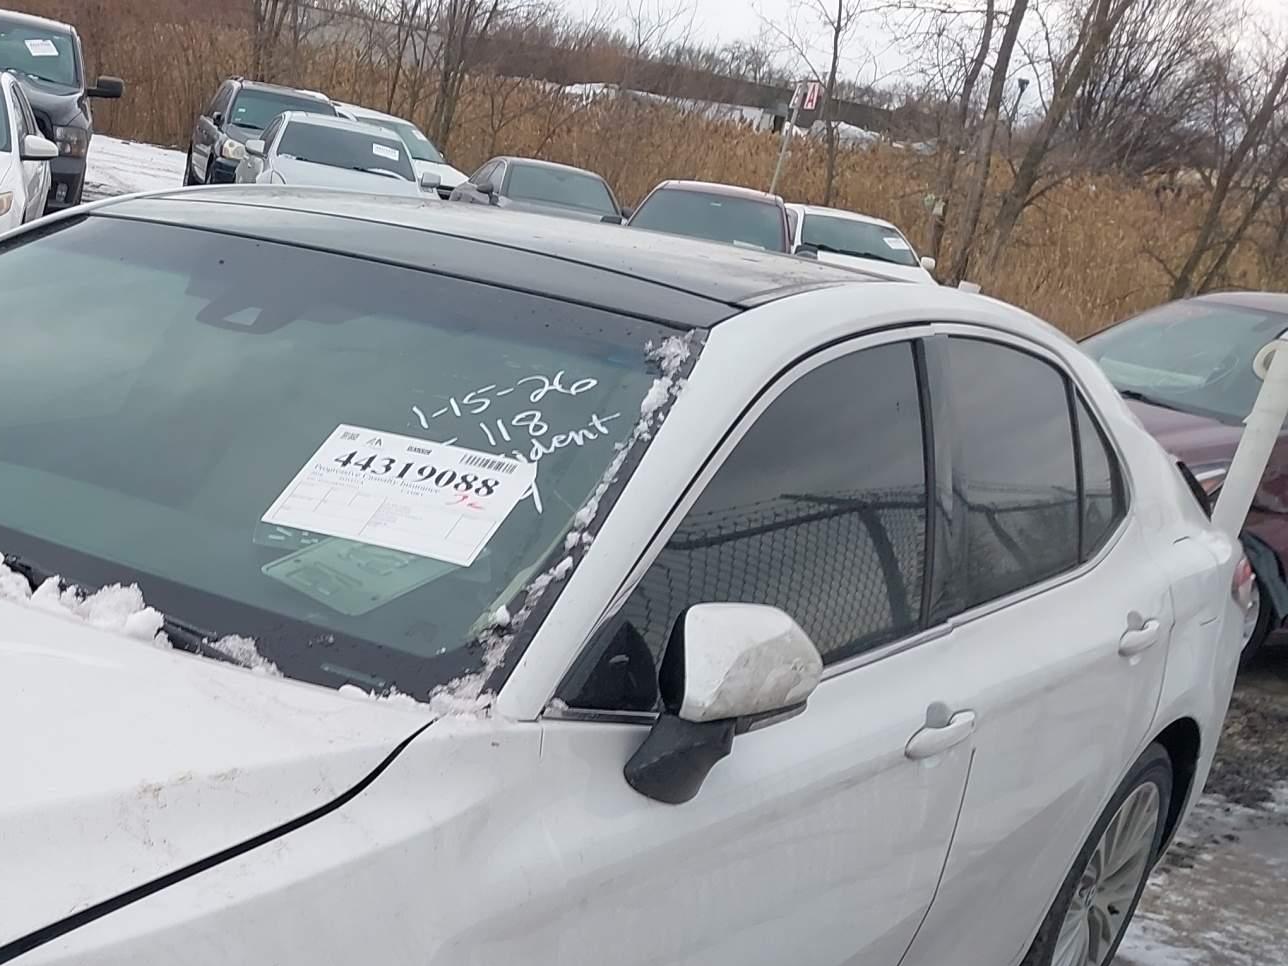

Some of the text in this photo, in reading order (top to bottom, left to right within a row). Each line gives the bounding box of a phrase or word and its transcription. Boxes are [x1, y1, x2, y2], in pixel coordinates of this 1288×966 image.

[412, 371, 598, 429] 1-15-26
[480, 410, 548, 446] 118
[334, 450, 500, 498] 44319088
